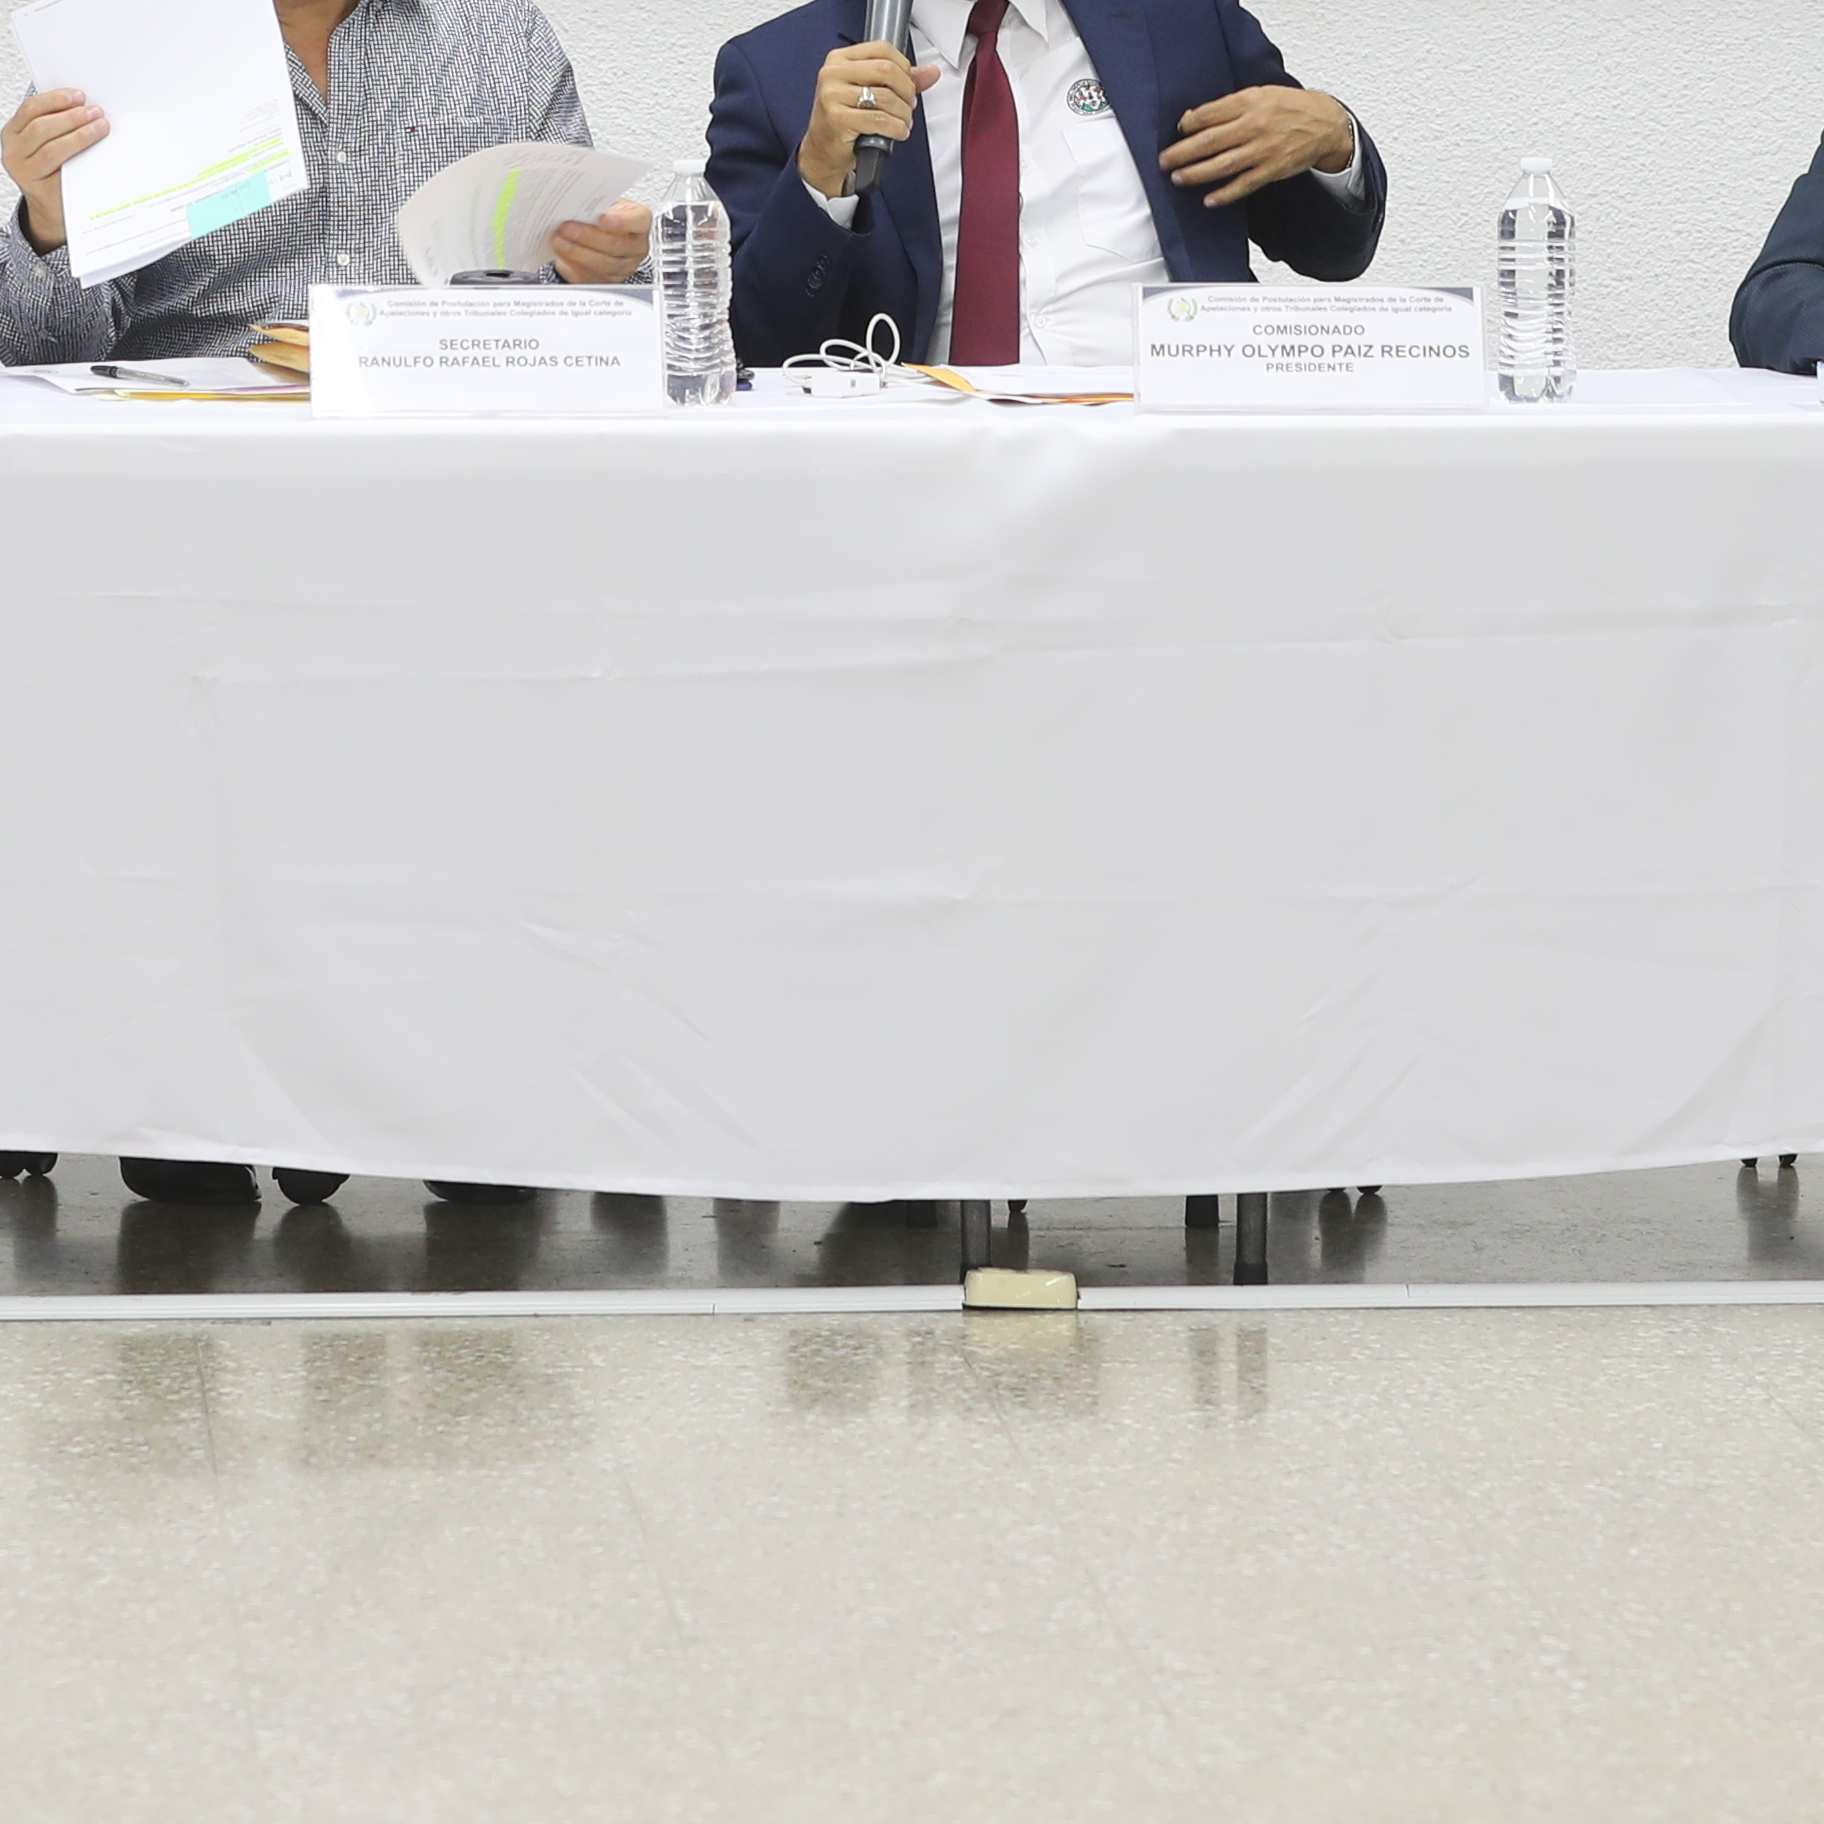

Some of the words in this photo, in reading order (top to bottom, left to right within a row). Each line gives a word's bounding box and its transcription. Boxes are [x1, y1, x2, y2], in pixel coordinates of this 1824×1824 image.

[1252, 324, 1366, 336] COMISIONADO
[438, 338, 540, 351] SECRETARIO
[1149, 343, 1234, 359] MURPHY
[1240, 343, 1325, 359] OLYMPO
[1331, 343, 1375, 359] PAIZ
[1380, 343, 1470, 359] RECINOS
[358, 355, 434, 369] RANULFO
[438, 355, 501, 368] RAFAEL
[505, 354, 558, 368] ROJAS
[562, 354, 621, 368] CETINA
[1266, 362, 1354, 373] PRESIDENTE
